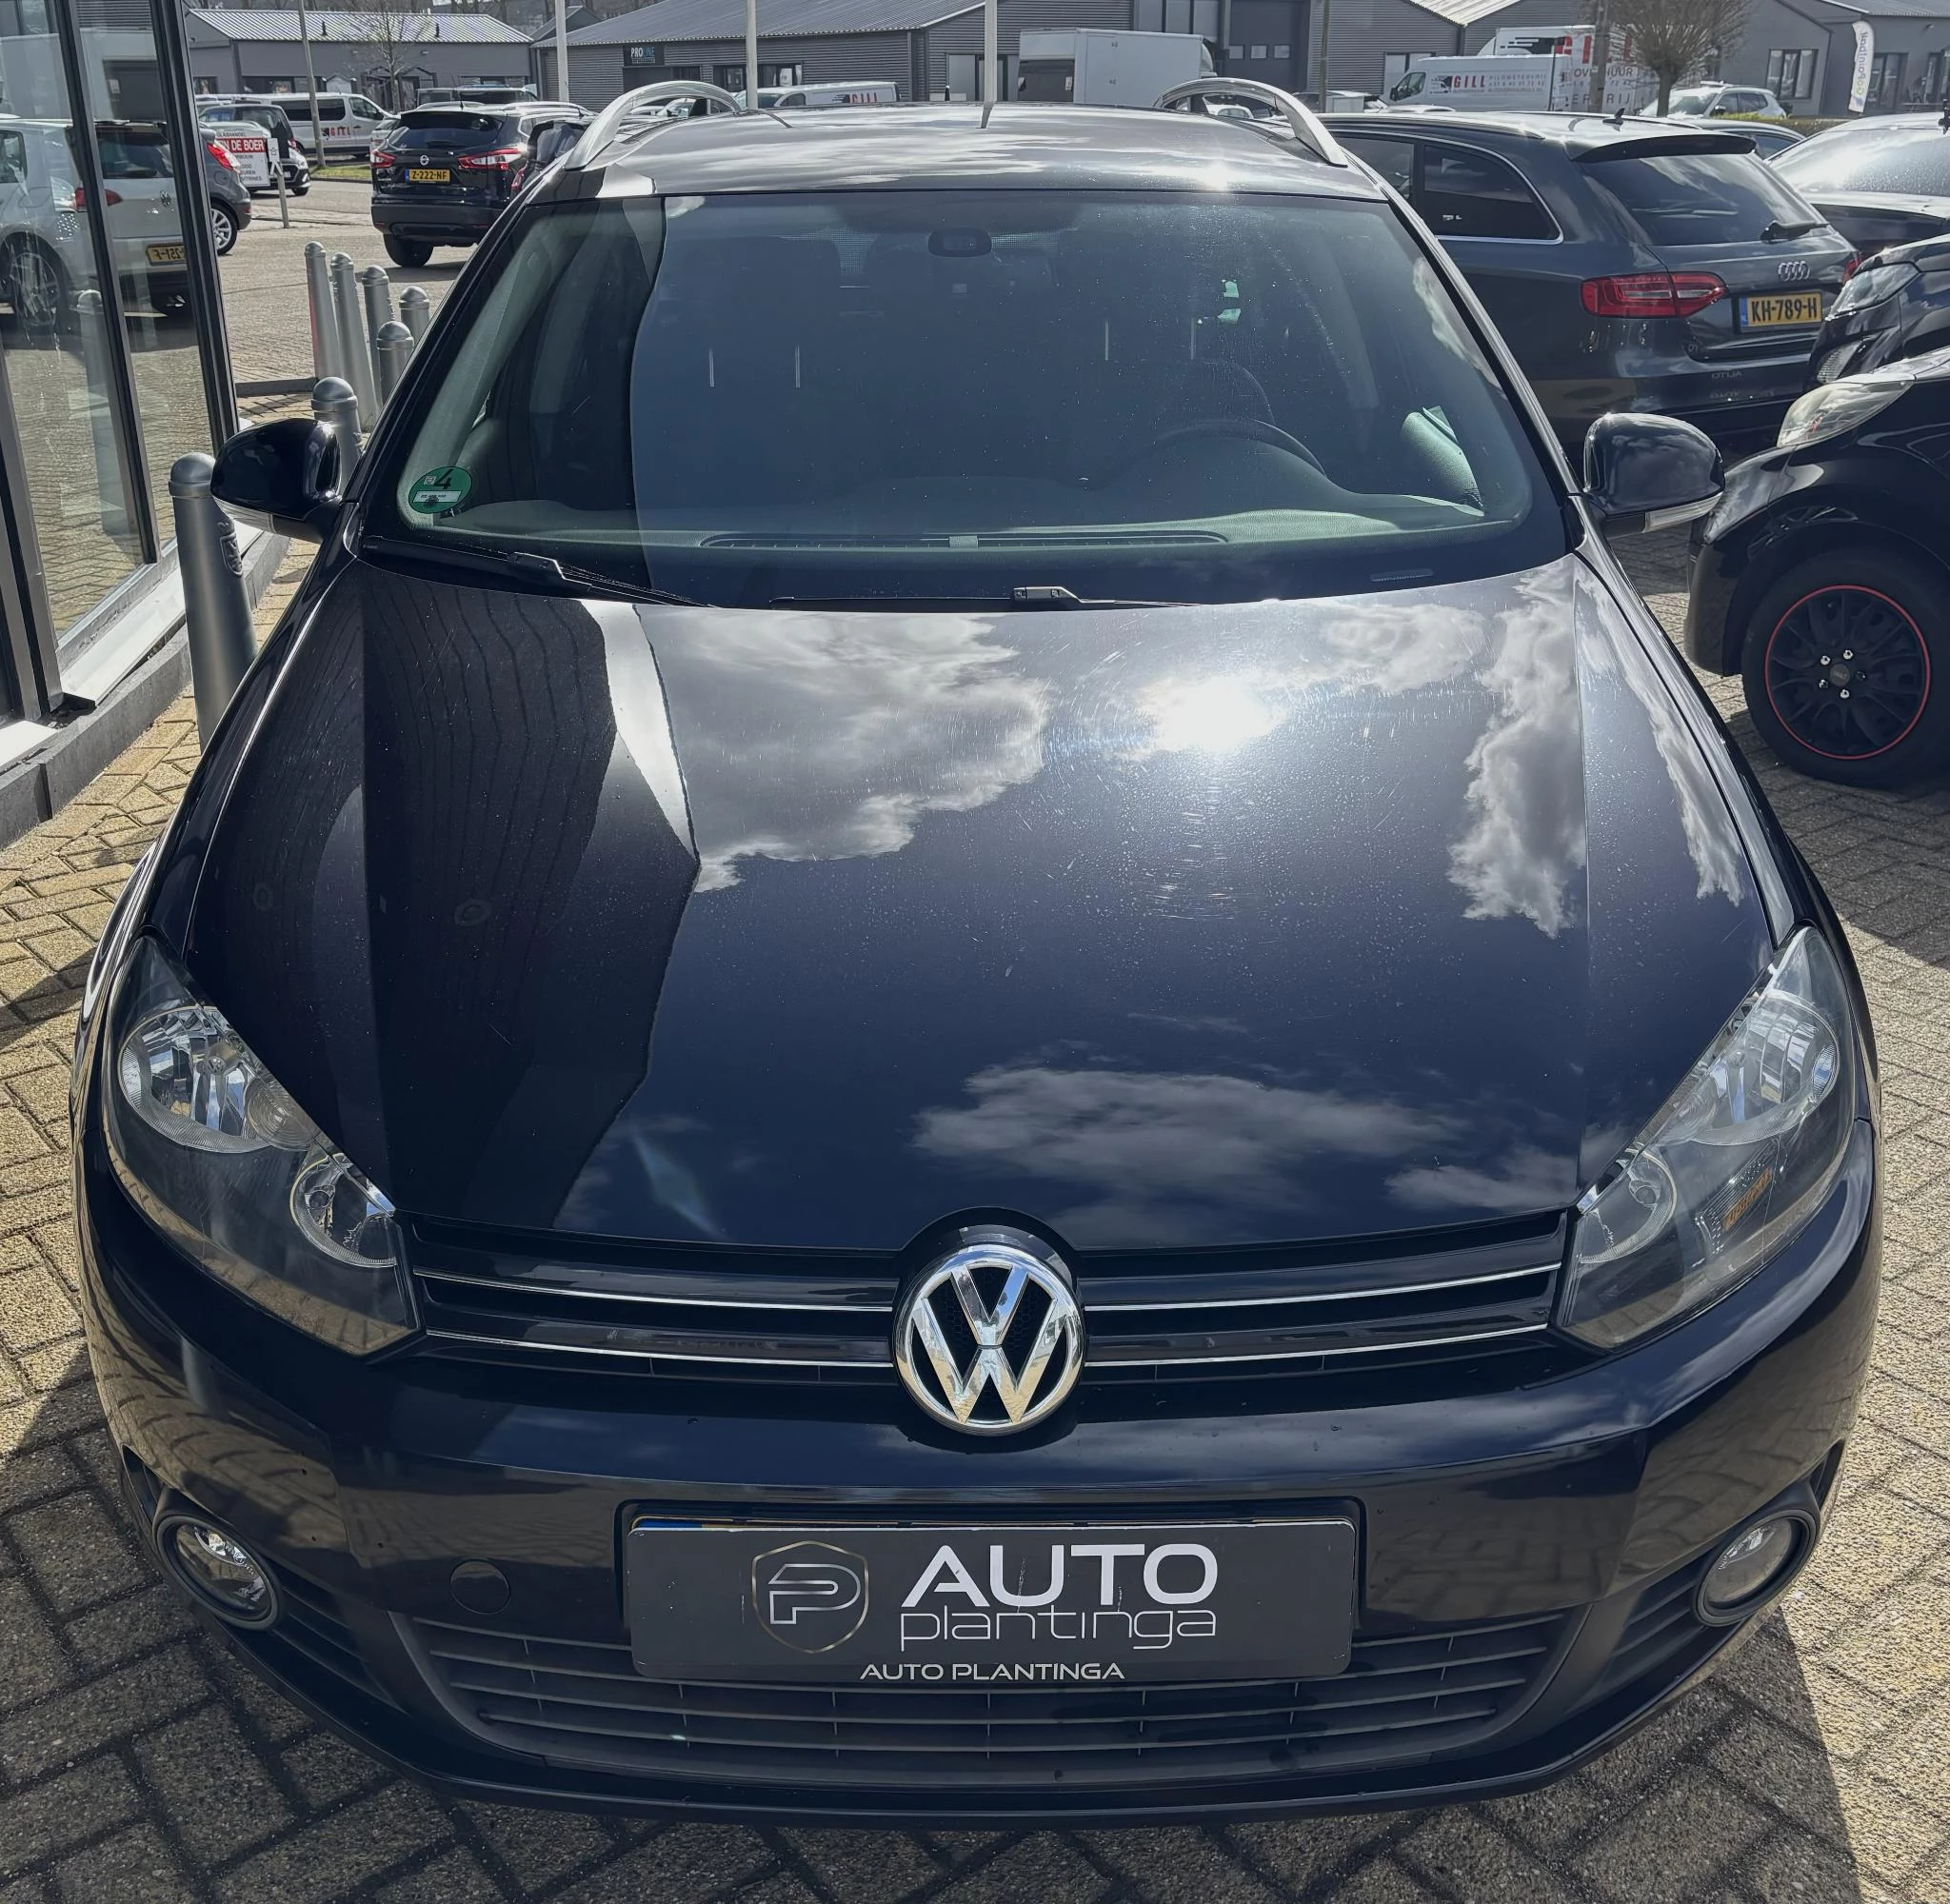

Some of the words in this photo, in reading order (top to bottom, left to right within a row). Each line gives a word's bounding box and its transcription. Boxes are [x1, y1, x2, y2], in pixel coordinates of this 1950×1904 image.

[1453, 75, 1486, 89] GILL
[230, 139, 243, 151] DE
[243, 139, 265, 151] BOER
[411, 170, 448, 180] Z-222-NF
[1751, 296, 1818, 323] KH-789-H
[433, 468, 454, 489] 4
[901, 1543, 1218, 1608] AUTO
[900, 1603, 1218, 1652] plantinga
[859, 1662, 945, 1681] AUTO
[950, 1662, 1125, 1681] PLANTINGA
